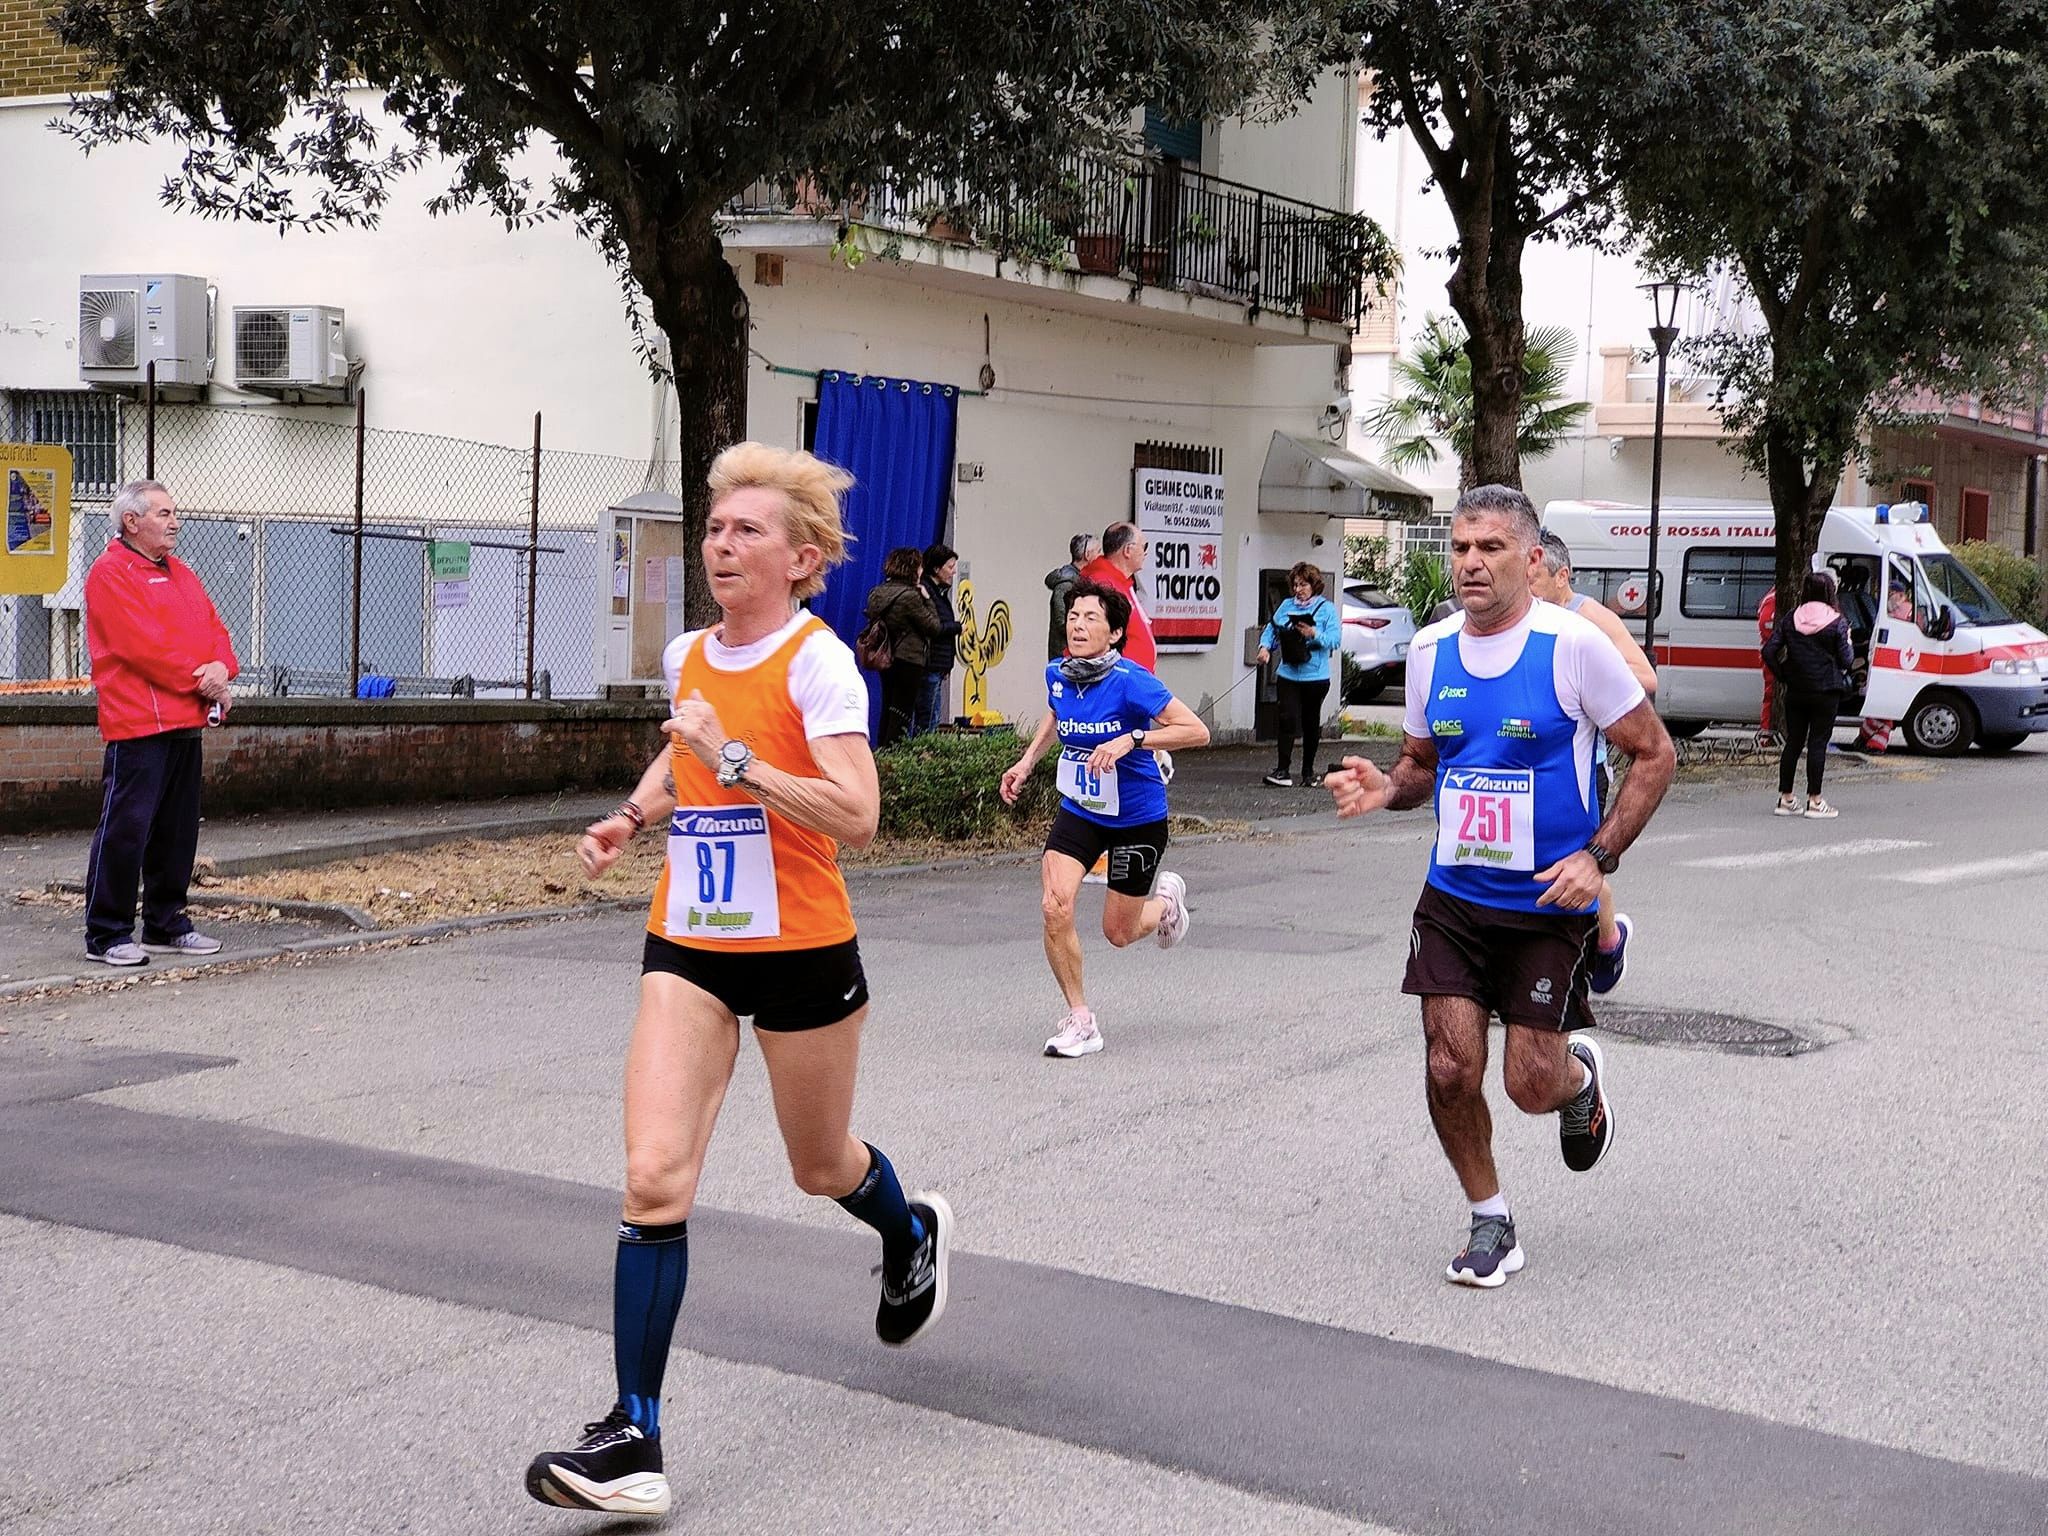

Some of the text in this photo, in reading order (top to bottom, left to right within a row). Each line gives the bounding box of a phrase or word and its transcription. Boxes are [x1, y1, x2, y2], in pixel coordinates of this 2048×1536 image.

[1667, 526, 1721, 537] ROSSA
[1155, 541, 1190, 569] san
[1156, 573, 1221, 601] marco
[1496, 730, 1537, 739] COTIGNOLA
[1502, 725, 1530, 733] PODISTI
[1458, 794, 1512, 843] 251
[696, 841, 735, 903] 87
